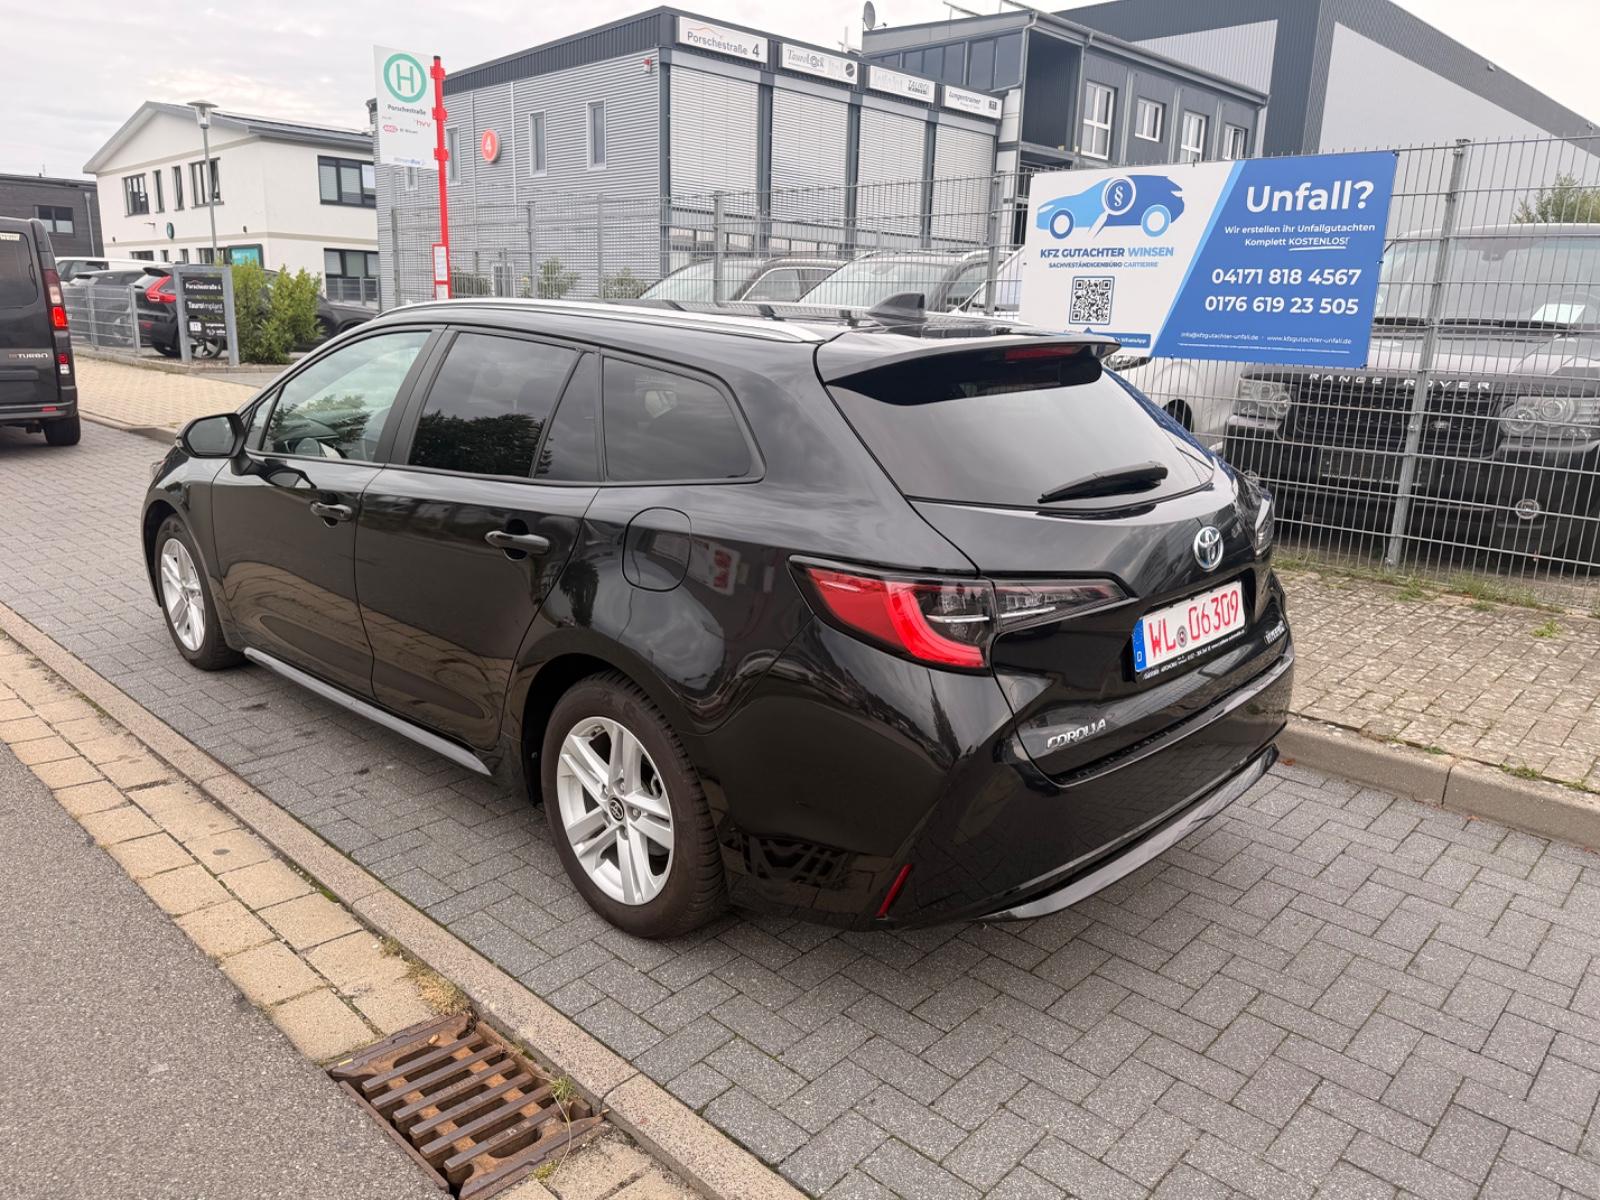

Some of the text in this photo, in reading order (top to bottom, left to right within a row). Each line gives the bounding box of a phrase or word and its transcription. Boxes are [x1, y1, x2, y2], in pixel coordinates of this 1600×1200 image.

[687, 31, 760, 58] Porschestraße 4
[396, 63, 415, 94] H
[1246, 180, 1374, 213] Unfall?
[1224, 226, 1241, 234] Wir
[1242, 225, 1281, 234] erstellen
[1297, 223, 1376, 235] Unfallgutachten
[1245, 236, 1350, 248] Komplett KOSTENLOS!
[1040, 246, 1174, 259] KFZ GUTACHTER WINSEN
[1211, 268, 1362, 286] 04171 818 4567
[1205, 296, 1360, 315] 0176 619 23 505
[1308, 373, 1384, 385] RANGE
[1148, 617, 1177, 659] WL
[1188, 589, 1239, 641] 06309
[1047, 718, 1107, 749] COROLLA
